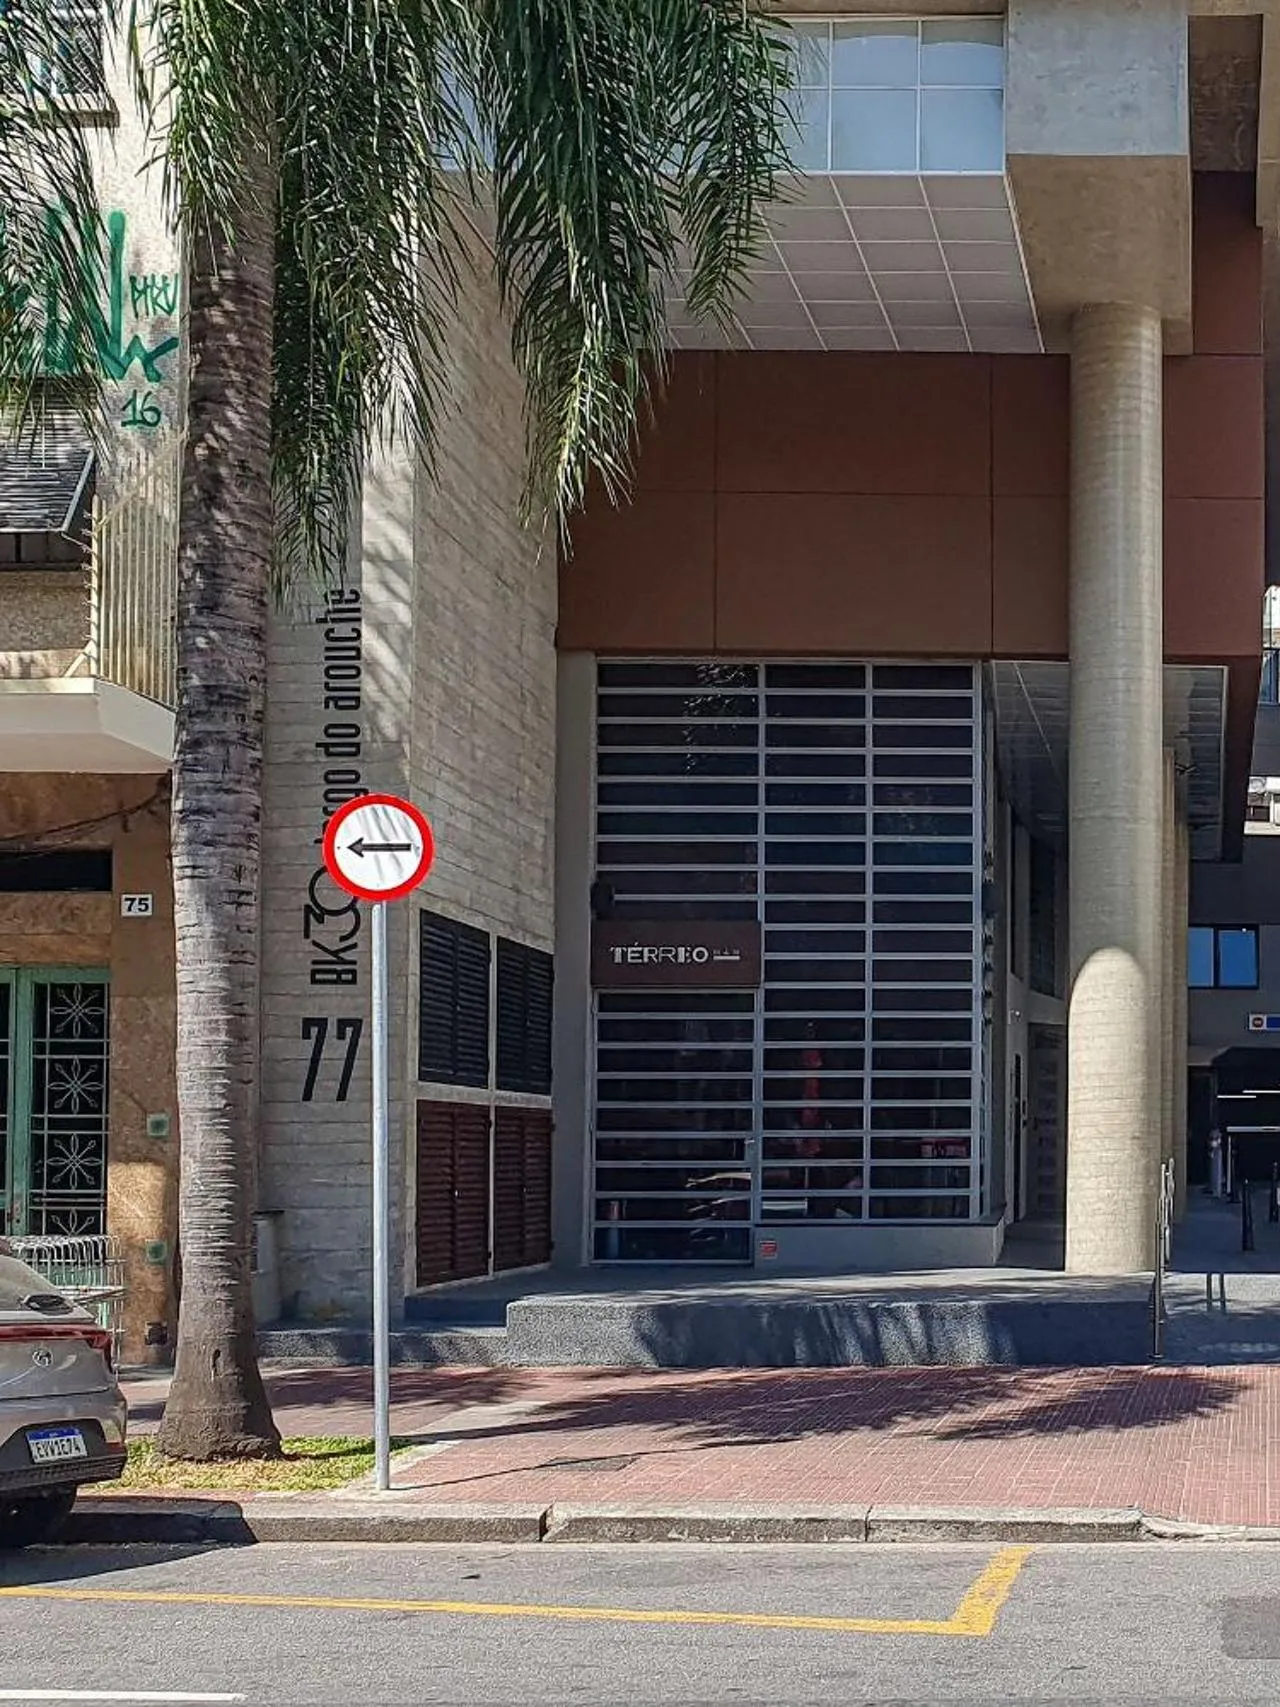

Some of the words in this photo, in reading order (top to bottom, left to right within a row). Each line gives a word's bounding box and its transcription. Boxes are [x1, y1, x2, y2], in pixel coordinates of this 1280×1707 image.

[121, 389, 162, 428] 16
[315, 588, 362, 710] arouche
[315, 723, 361, 757] do
[123, 896, 150, 914] 75
[609, 941, 709, 964] TÉRREO
[301, 1017, 363, 1102] 77
